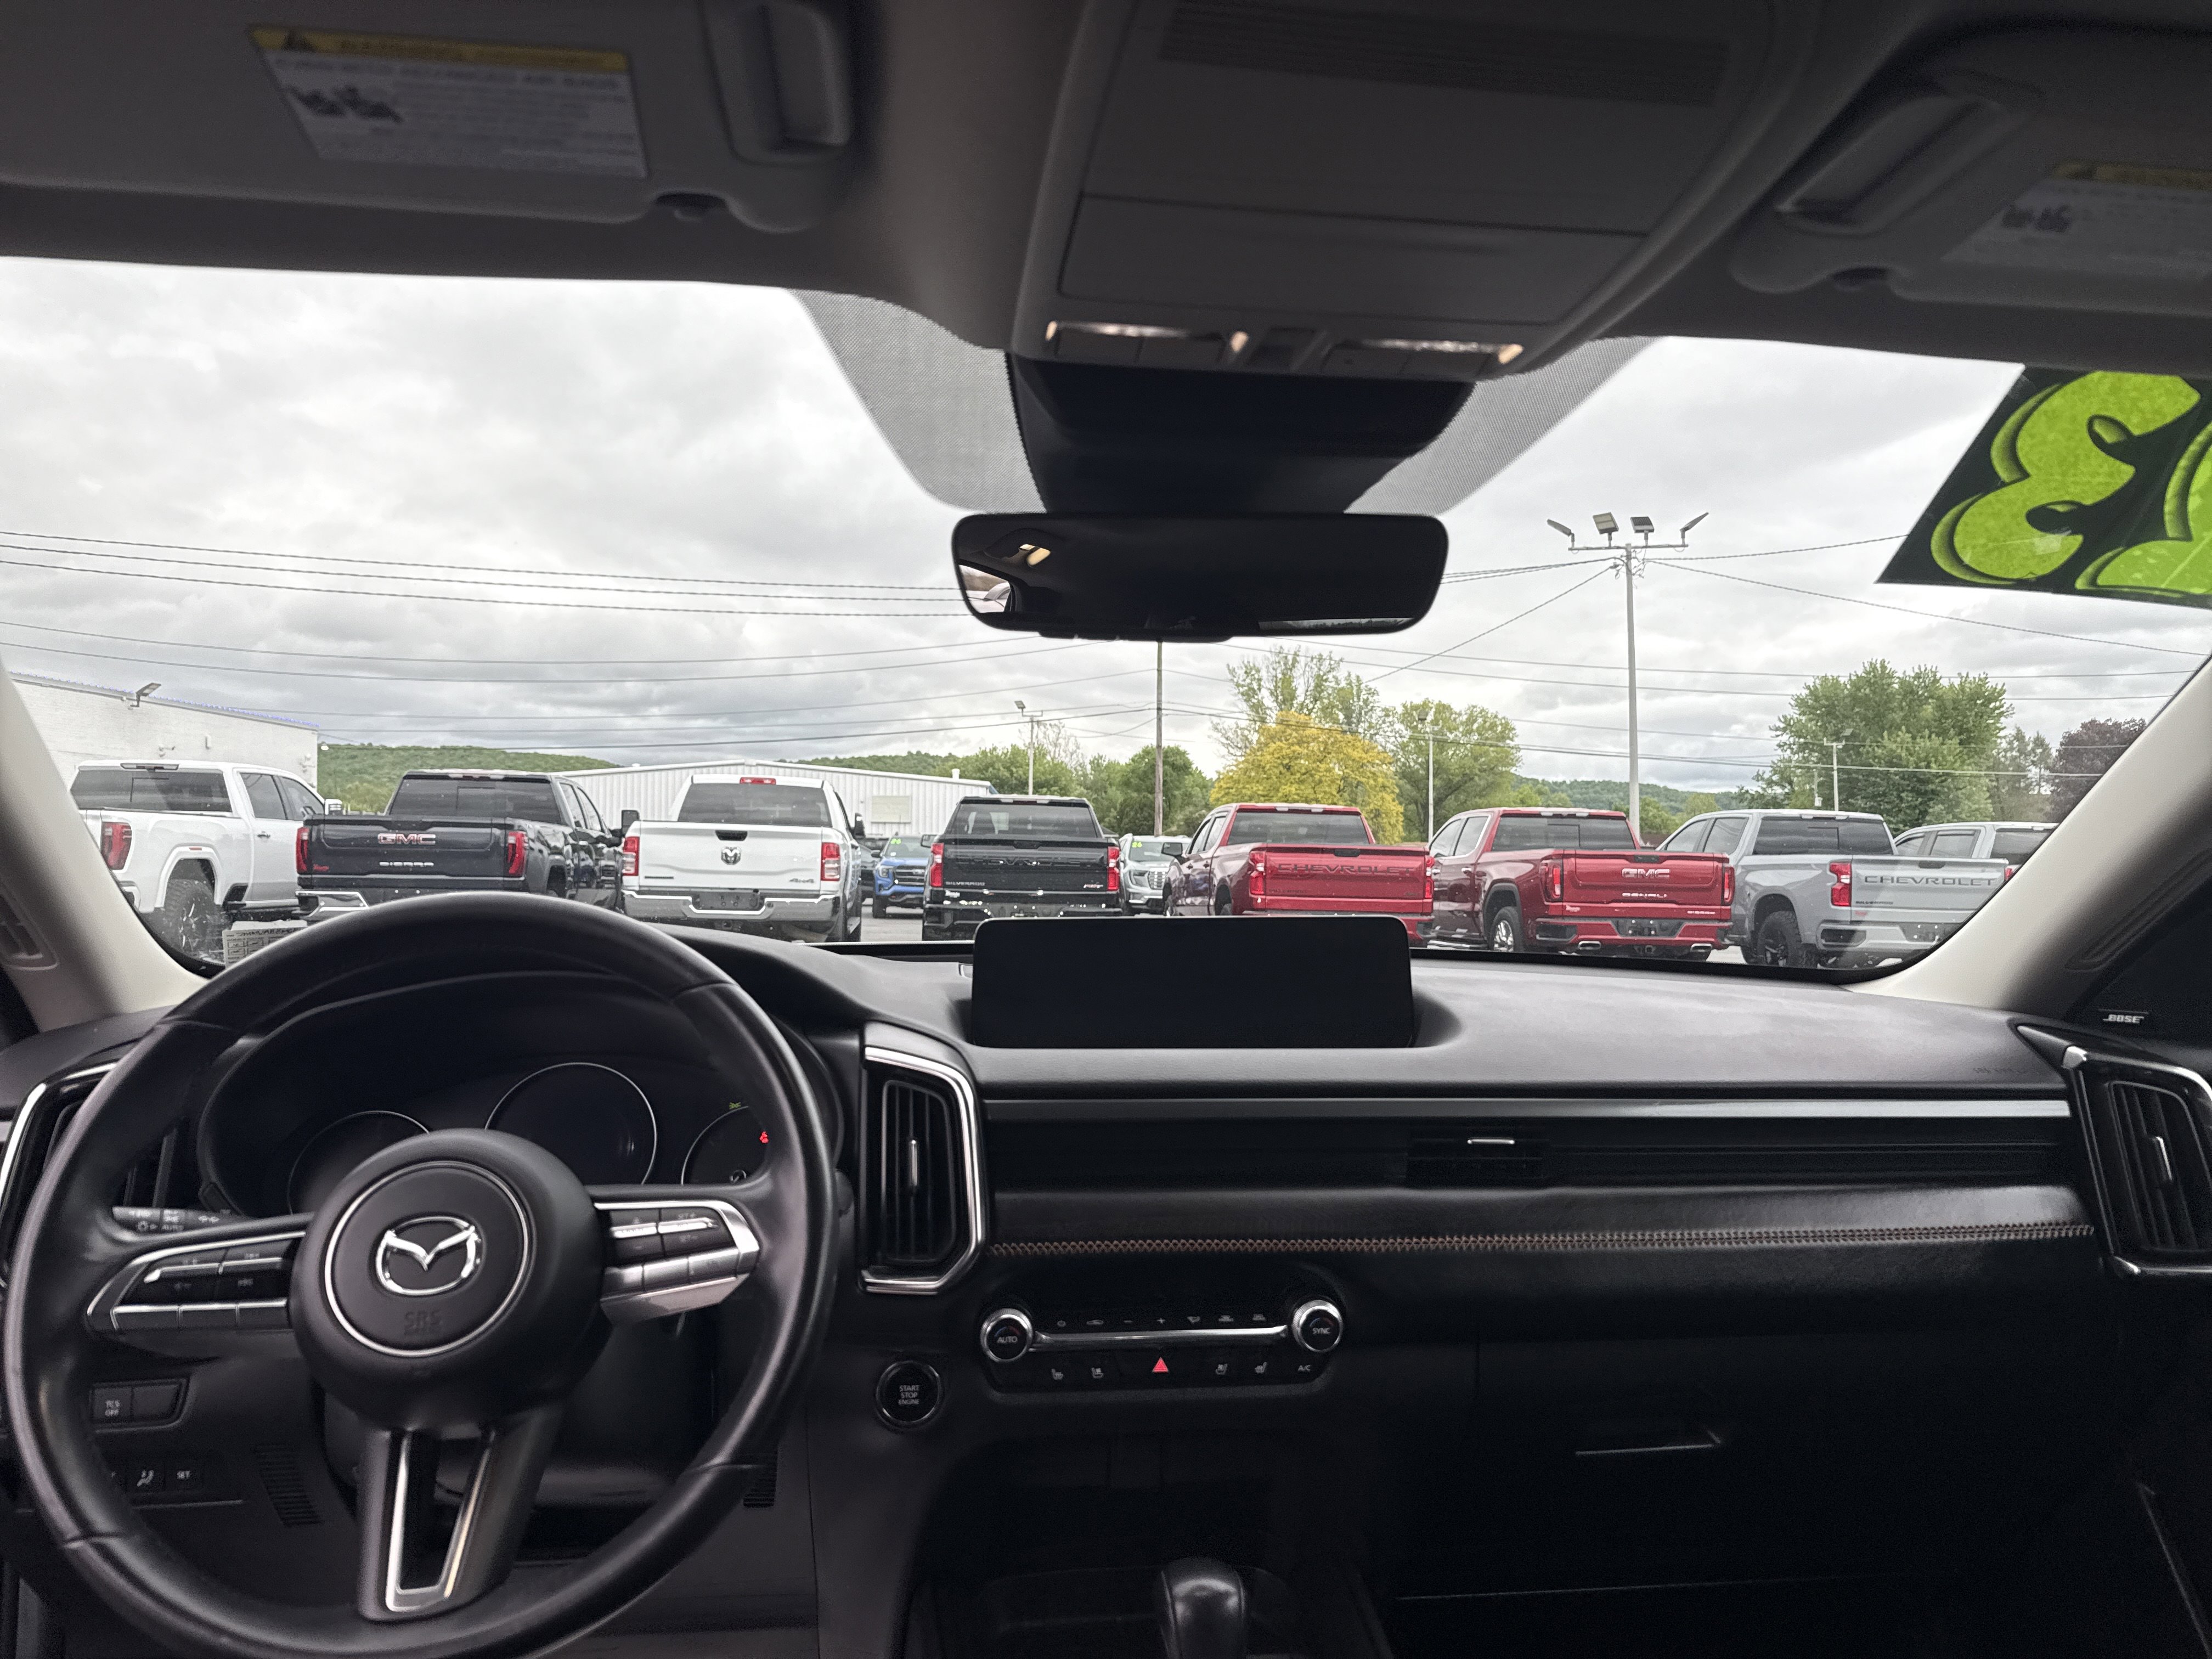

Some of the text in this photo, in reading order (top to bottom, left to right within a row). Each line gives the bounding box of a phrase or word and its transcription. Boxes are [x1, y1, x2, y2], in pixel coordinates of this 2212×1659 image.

[377, 833, 436, 845] GMC
[1278, 863, 1414, 874] CHEVROLET
[1622, 868, 1670, 878] GMC
[1864, 876, 1996, 886] CHEVROLET
[2102, 1014, 2145, 1023] BOSE
